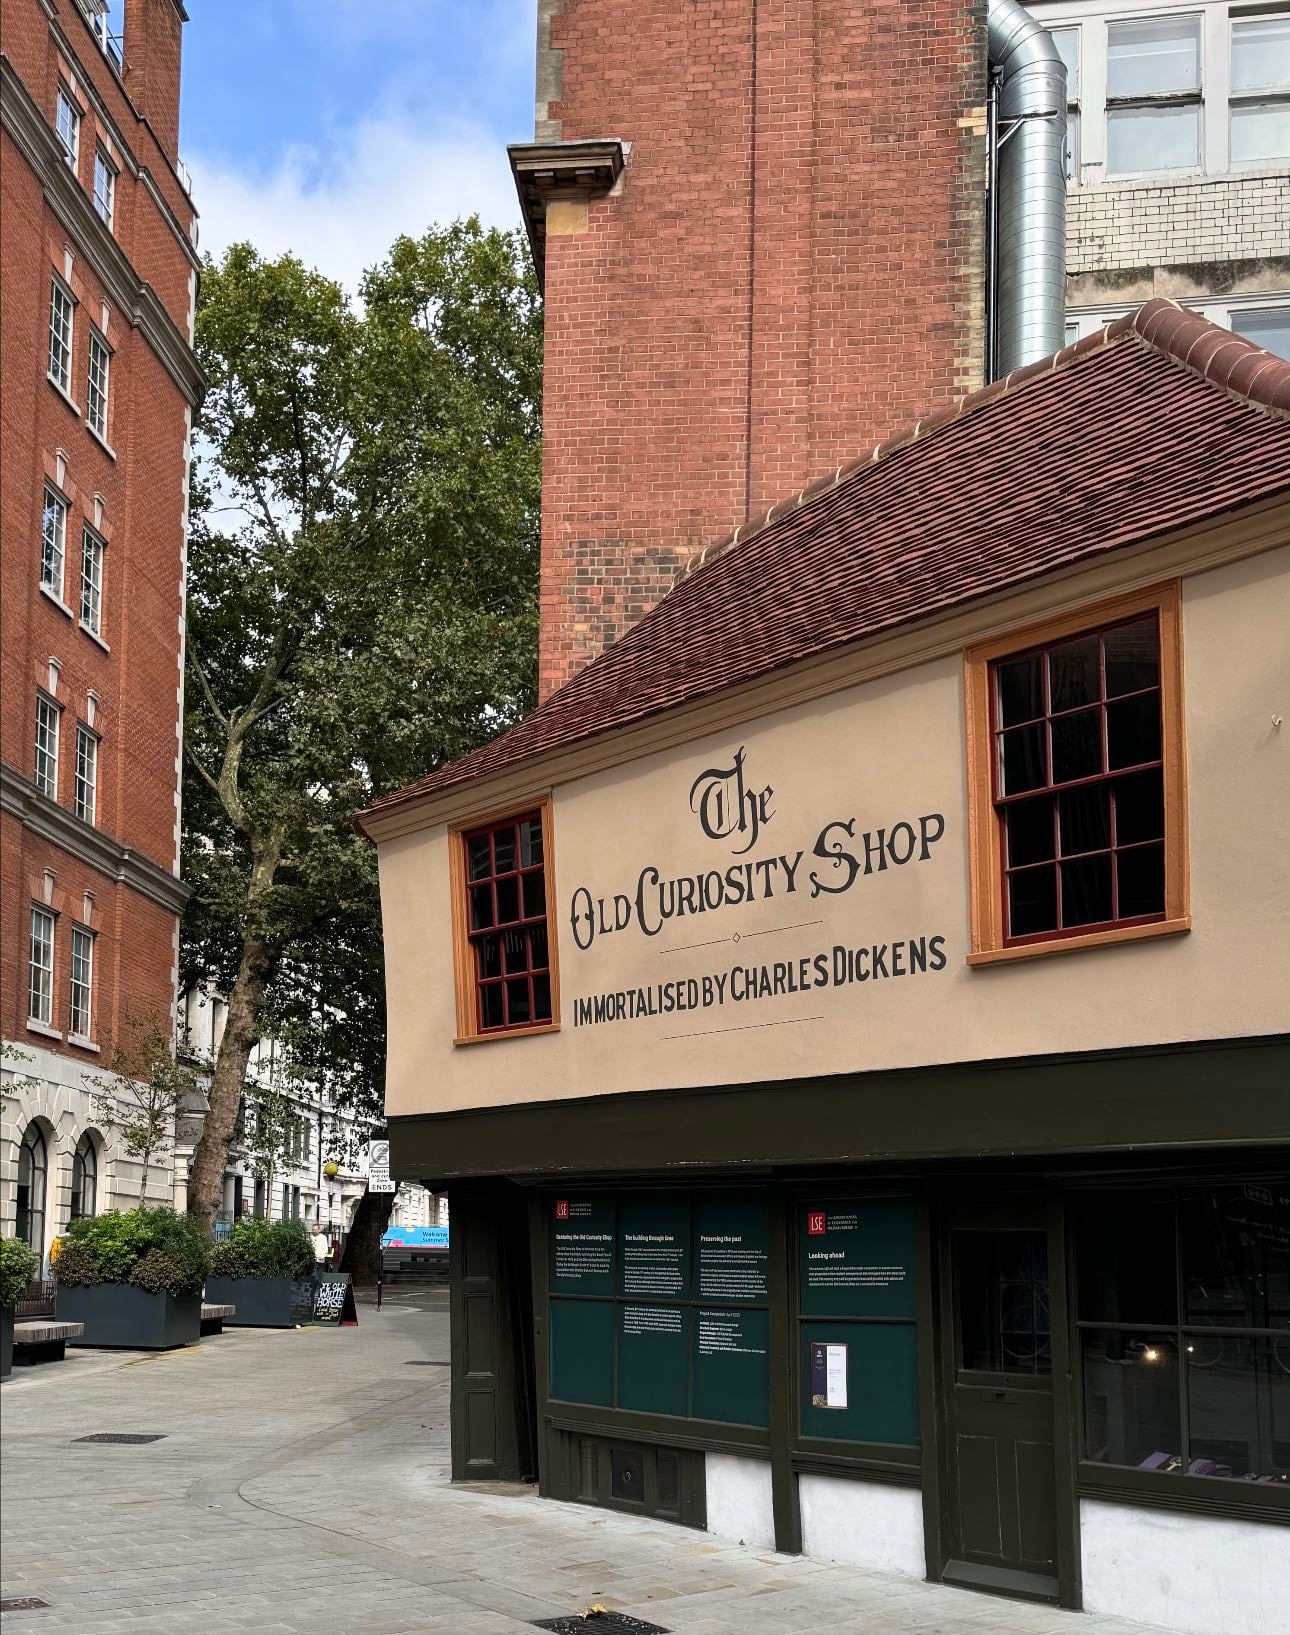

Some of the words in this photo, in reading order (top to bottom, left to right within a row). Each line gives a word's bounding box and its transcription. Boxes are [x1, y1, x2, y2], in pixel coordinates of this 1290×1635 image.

[689, 745, 776, 854] The
[570, 887, 632, 950] OLD
[635, 850, 804, 936] CURIOSITY
[809, 813, 945, 898] SHOP
[573, 979, 698, 1026] IMMORTALISED
[702, 973, 727, 1007] BY
[730, 954, 828, 1000] CHARLES
[833, 935, 947, 987] DICKENS
[811, 1216, 823, 1231] LSE
[632, 1234, 648, 1242] building
[700, 1235, 723, 1243] Preserving
[808, 1251, 829, 1260] Looking
[829, 1251, 845, 1259] ahead
[317, 1298, 345, 1308] HORSE
